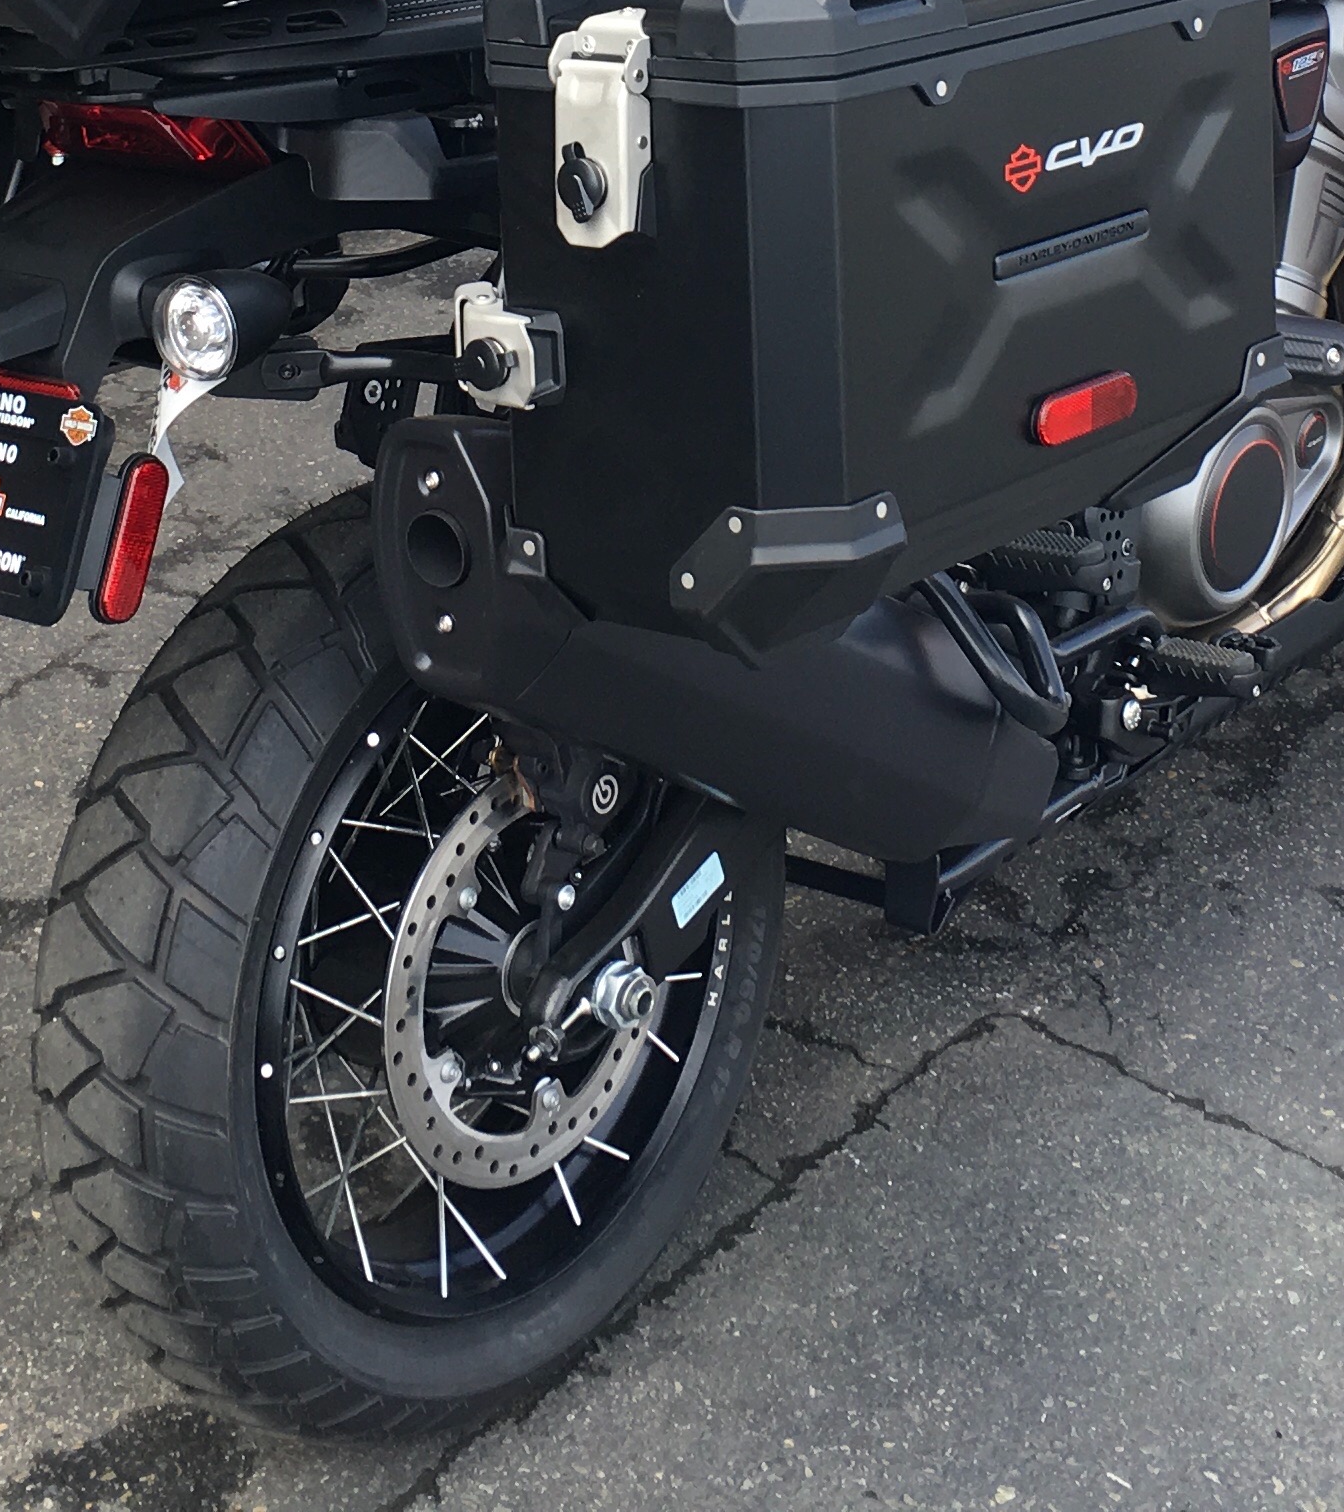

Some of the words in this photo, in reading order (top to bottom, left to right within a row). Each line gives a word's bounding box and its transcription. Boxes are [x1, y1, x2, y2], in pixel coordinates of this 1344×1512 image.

[1045, 122, 1144, 171] CVO
[1018, 221, 1135, 266] HARLEY-DAVIDSON
[5, 507, 45, 526] CALIFORNIA
